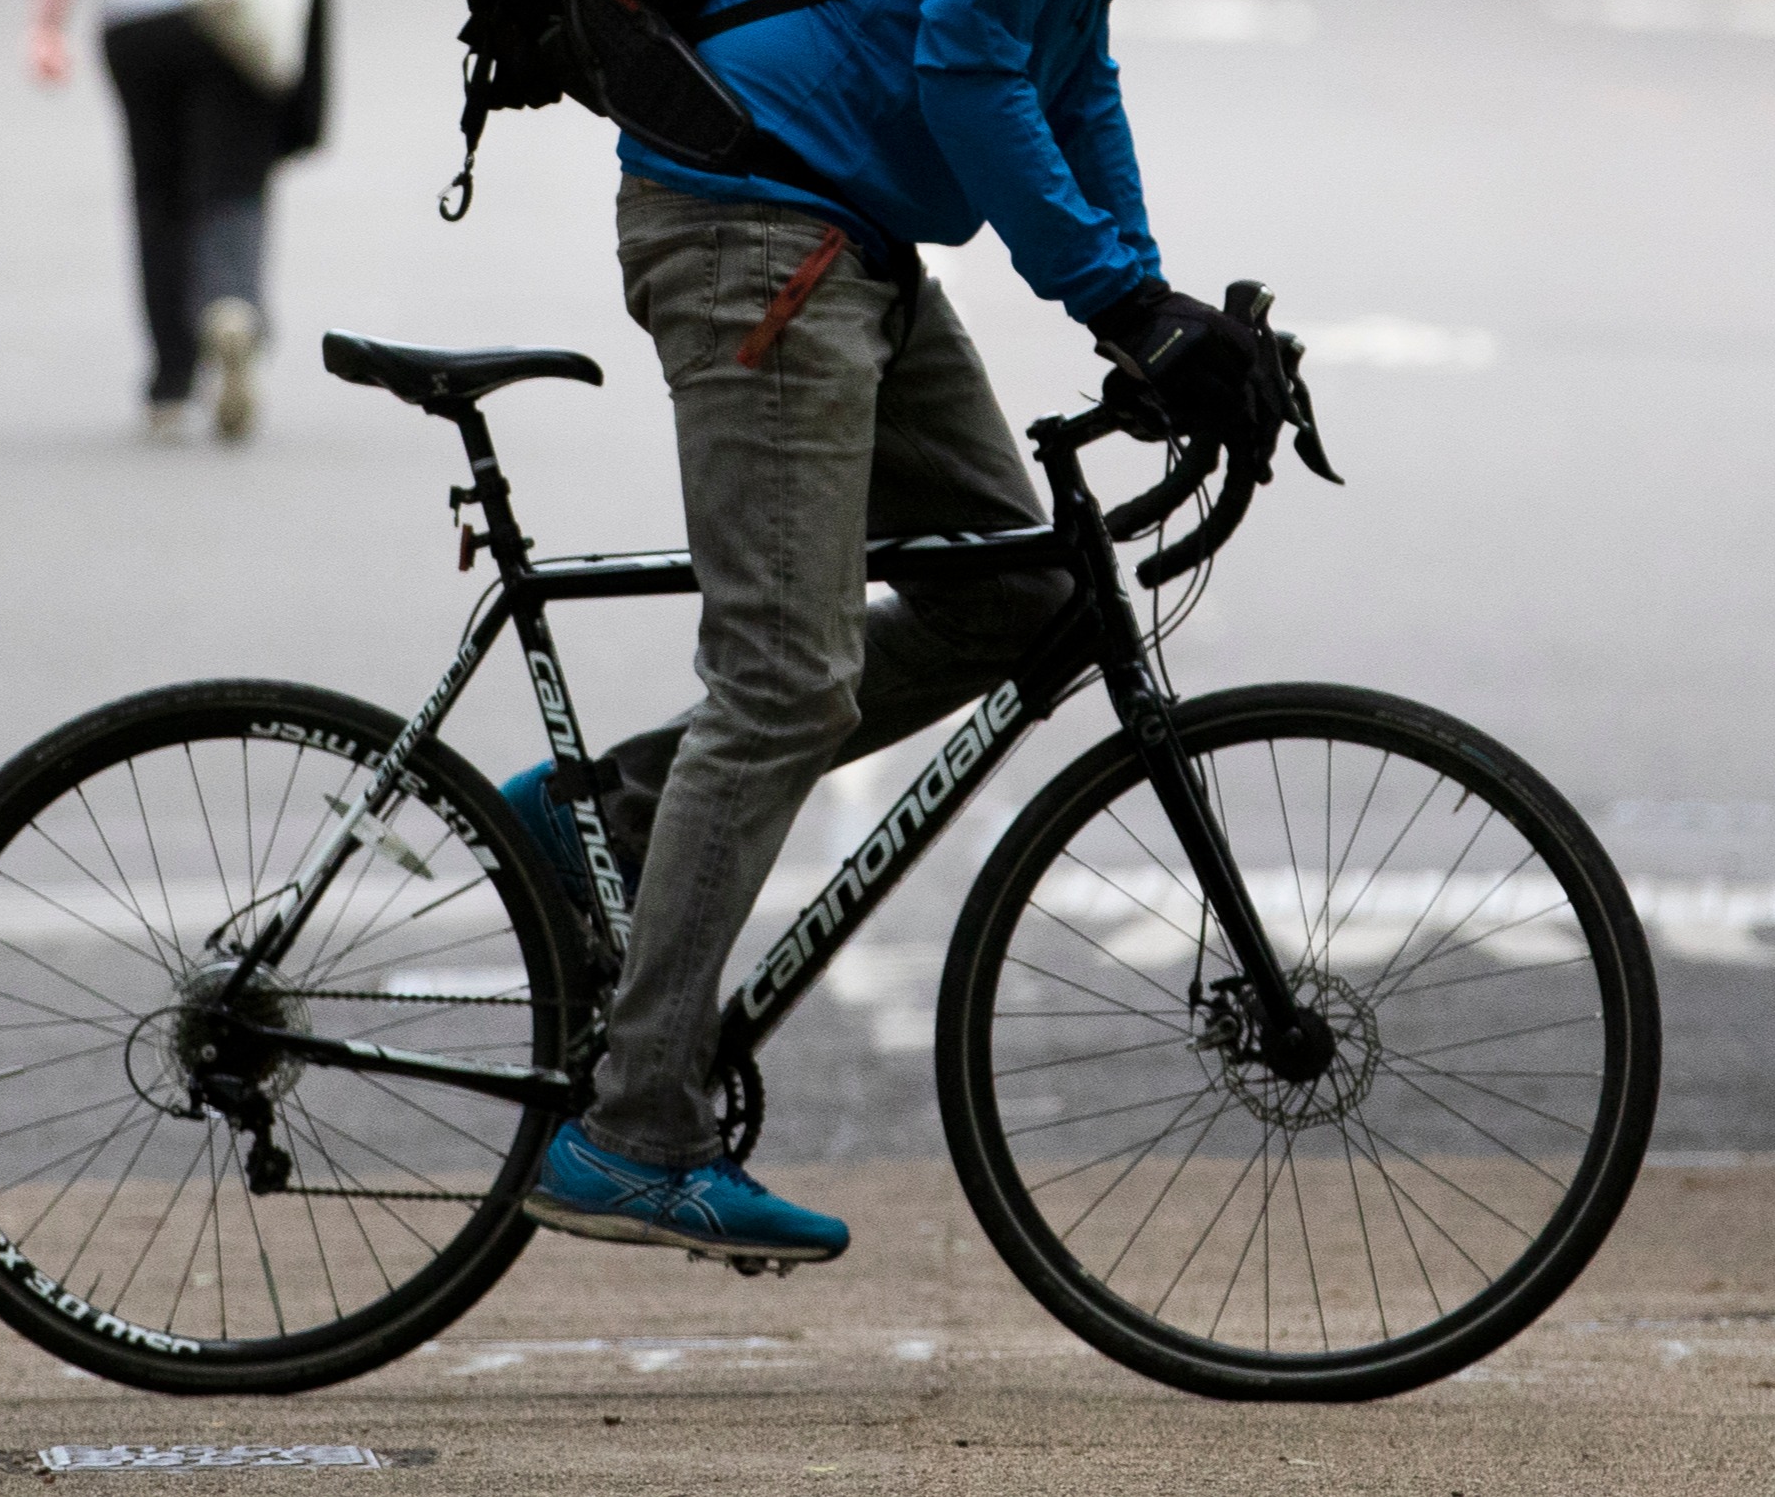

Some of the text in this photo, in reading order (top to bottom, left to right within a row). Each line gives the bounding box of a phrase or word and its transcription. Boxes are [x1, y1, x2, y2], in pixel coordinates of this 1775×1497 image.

[529, 649, 634, 952] cannndale
[742, 679, 1023, 1021] cannondale
[25, 1271, 90, 1321] 3.0
